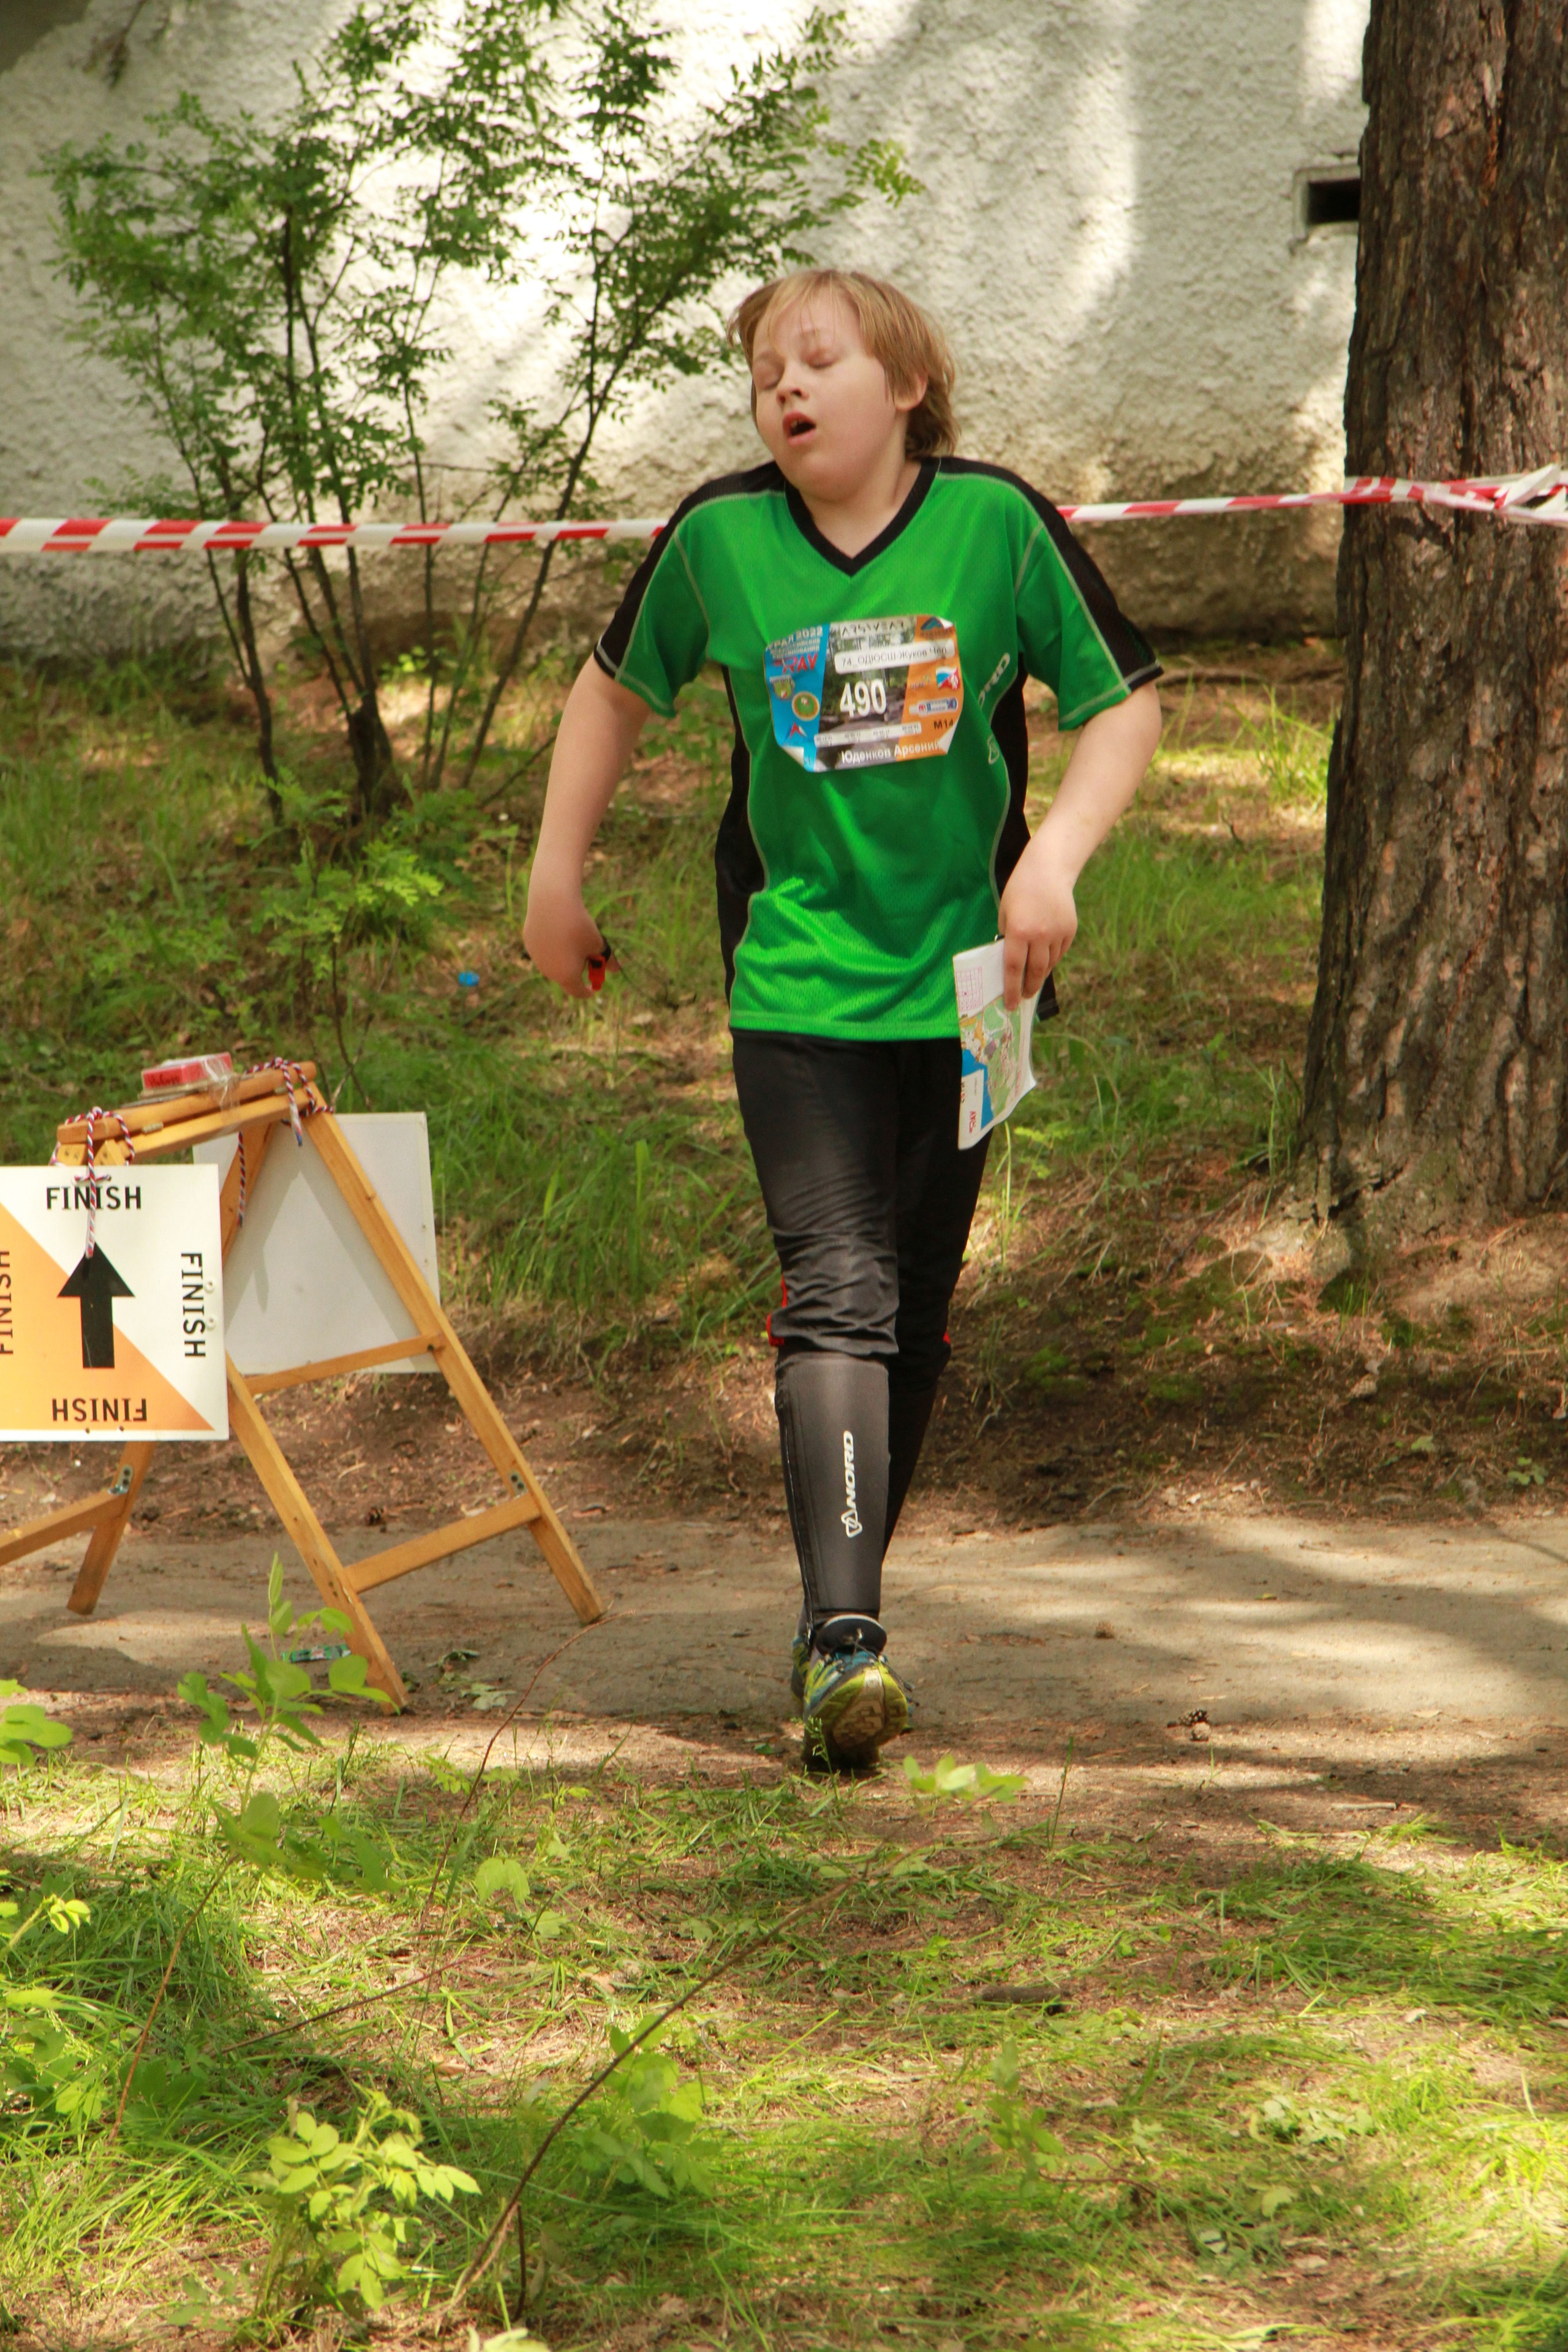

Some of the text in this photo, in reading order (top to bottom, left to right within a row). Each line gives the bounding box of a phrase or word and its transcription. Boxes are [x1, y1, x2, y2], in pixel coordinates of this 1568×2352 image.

[839, 678, 887, 718] 490
[46, 1185, 142, 1210] FINISH
[181, 1253, 206, 1357] FINISH
[51, 1398, 147, 1422] FINISH
[843, 1430, 857, 1510] NORD
